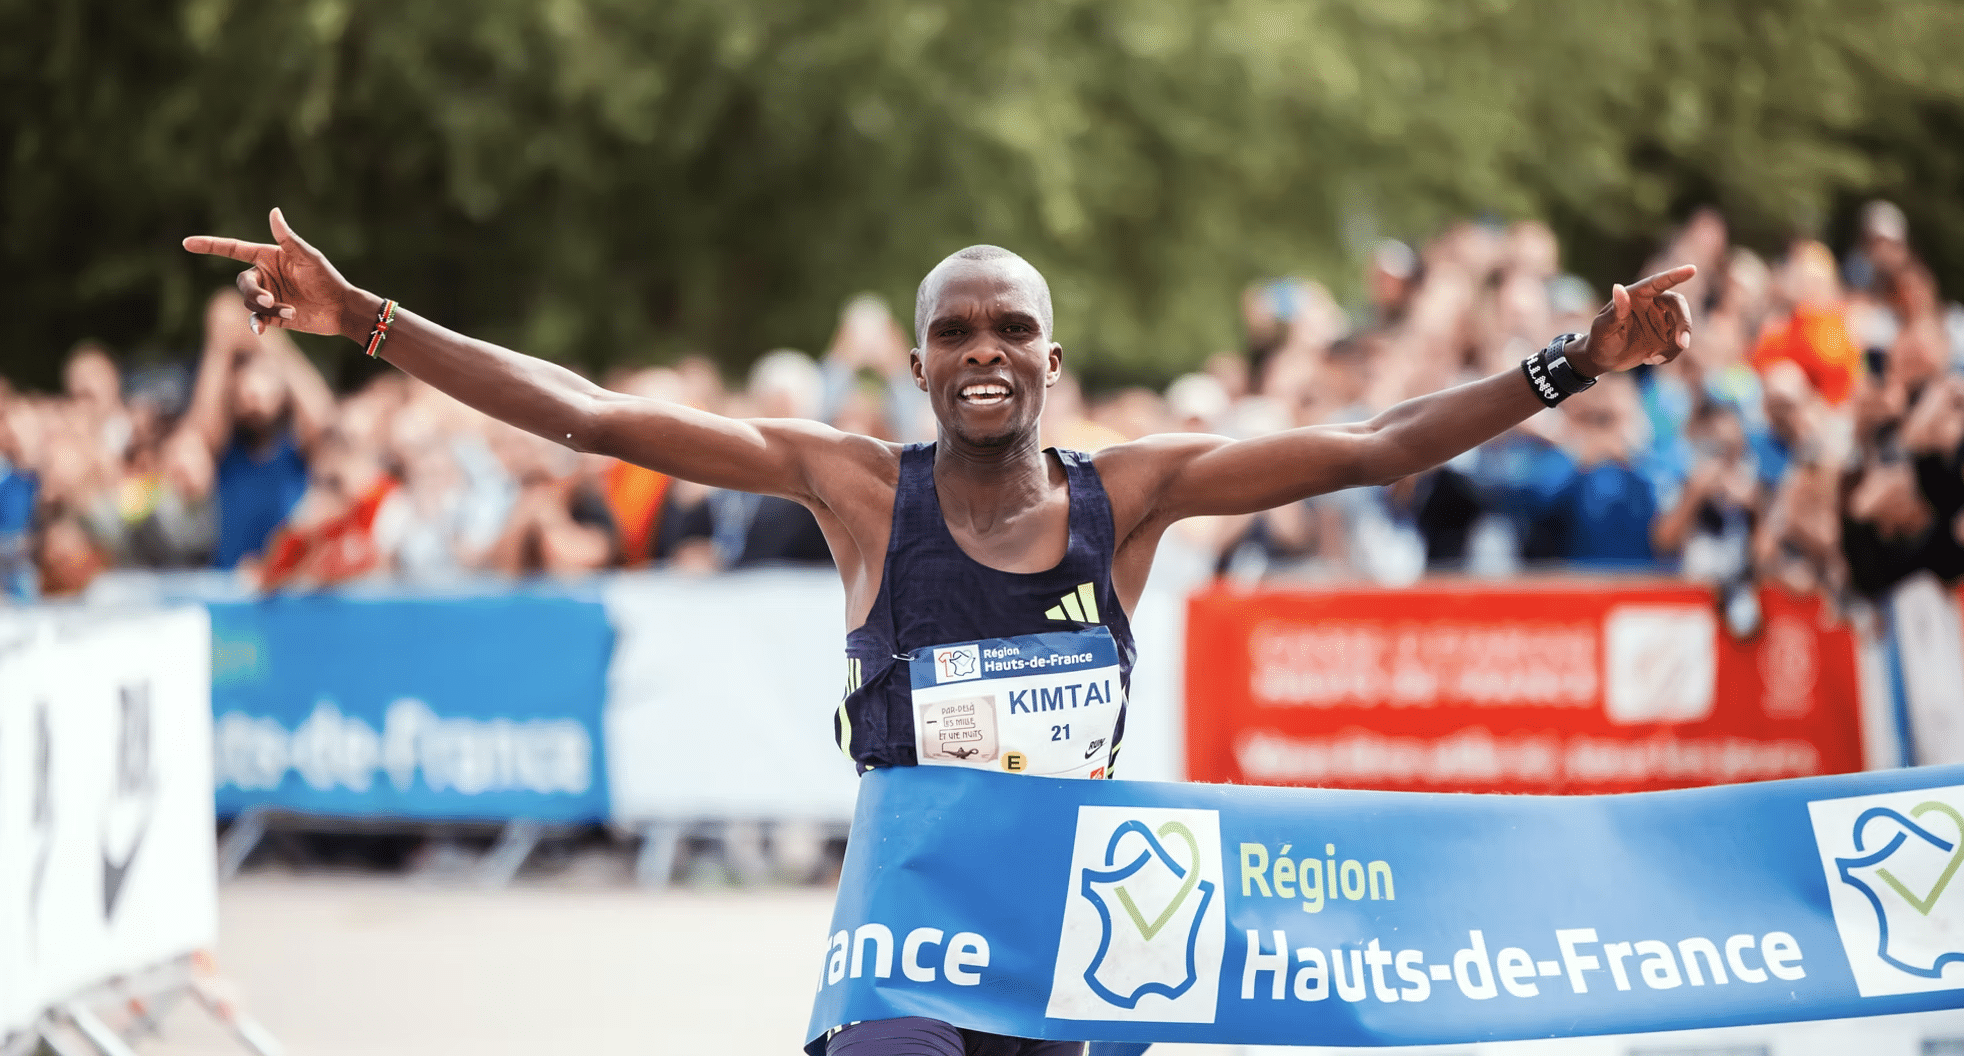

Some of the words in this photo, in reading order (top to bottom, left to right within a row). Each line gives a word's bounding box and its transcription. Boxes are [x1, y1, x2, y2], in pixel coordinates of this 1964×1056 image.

[983, 647, 1020, 659] Région
[984, 652, 1093, 672] Hauts-de-France
[1009, 680, 1111, 715] KIMTAI
[1051, 724, 1070, 741] 21
[1008, 755, 1021, 770] E
[1239, 842, 1396, 914] Région
[1241, 927, 1807, 1003] Hauts-de-France
